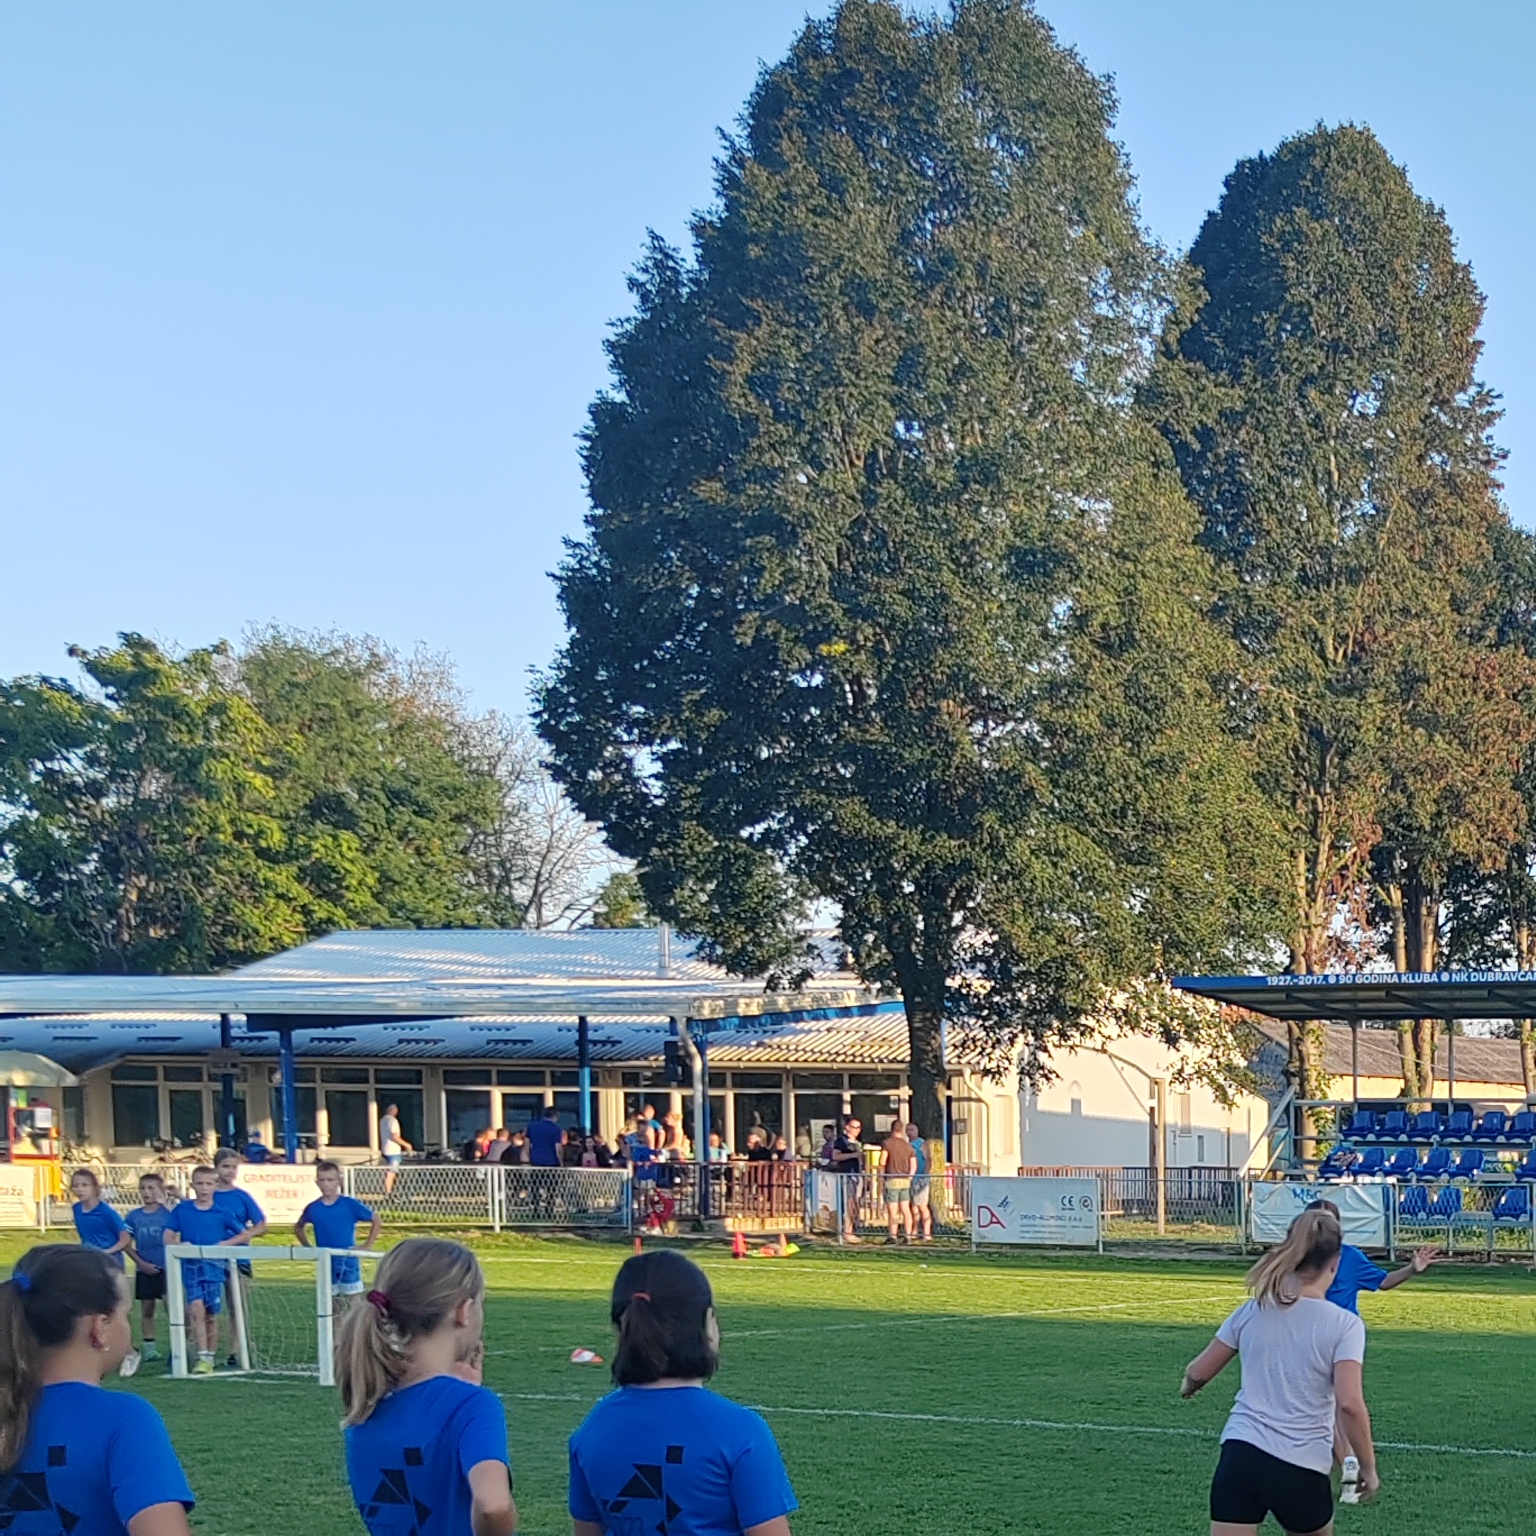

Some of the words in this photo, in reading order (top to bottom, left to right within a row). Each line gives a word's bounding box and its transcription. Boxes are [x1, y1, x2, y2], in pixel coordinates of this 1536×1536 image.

[1266, 975, 1326, 986] 1927.-2017.
[1338, 974, 1353, 984] 90
[1355, 973, 1399, 984] GODINA
[1401, 972, 1439, 983] KLUBA
[1452, 972, 1468, 982] NK
[243, 1174, 312, 1183] GRADITELJST
